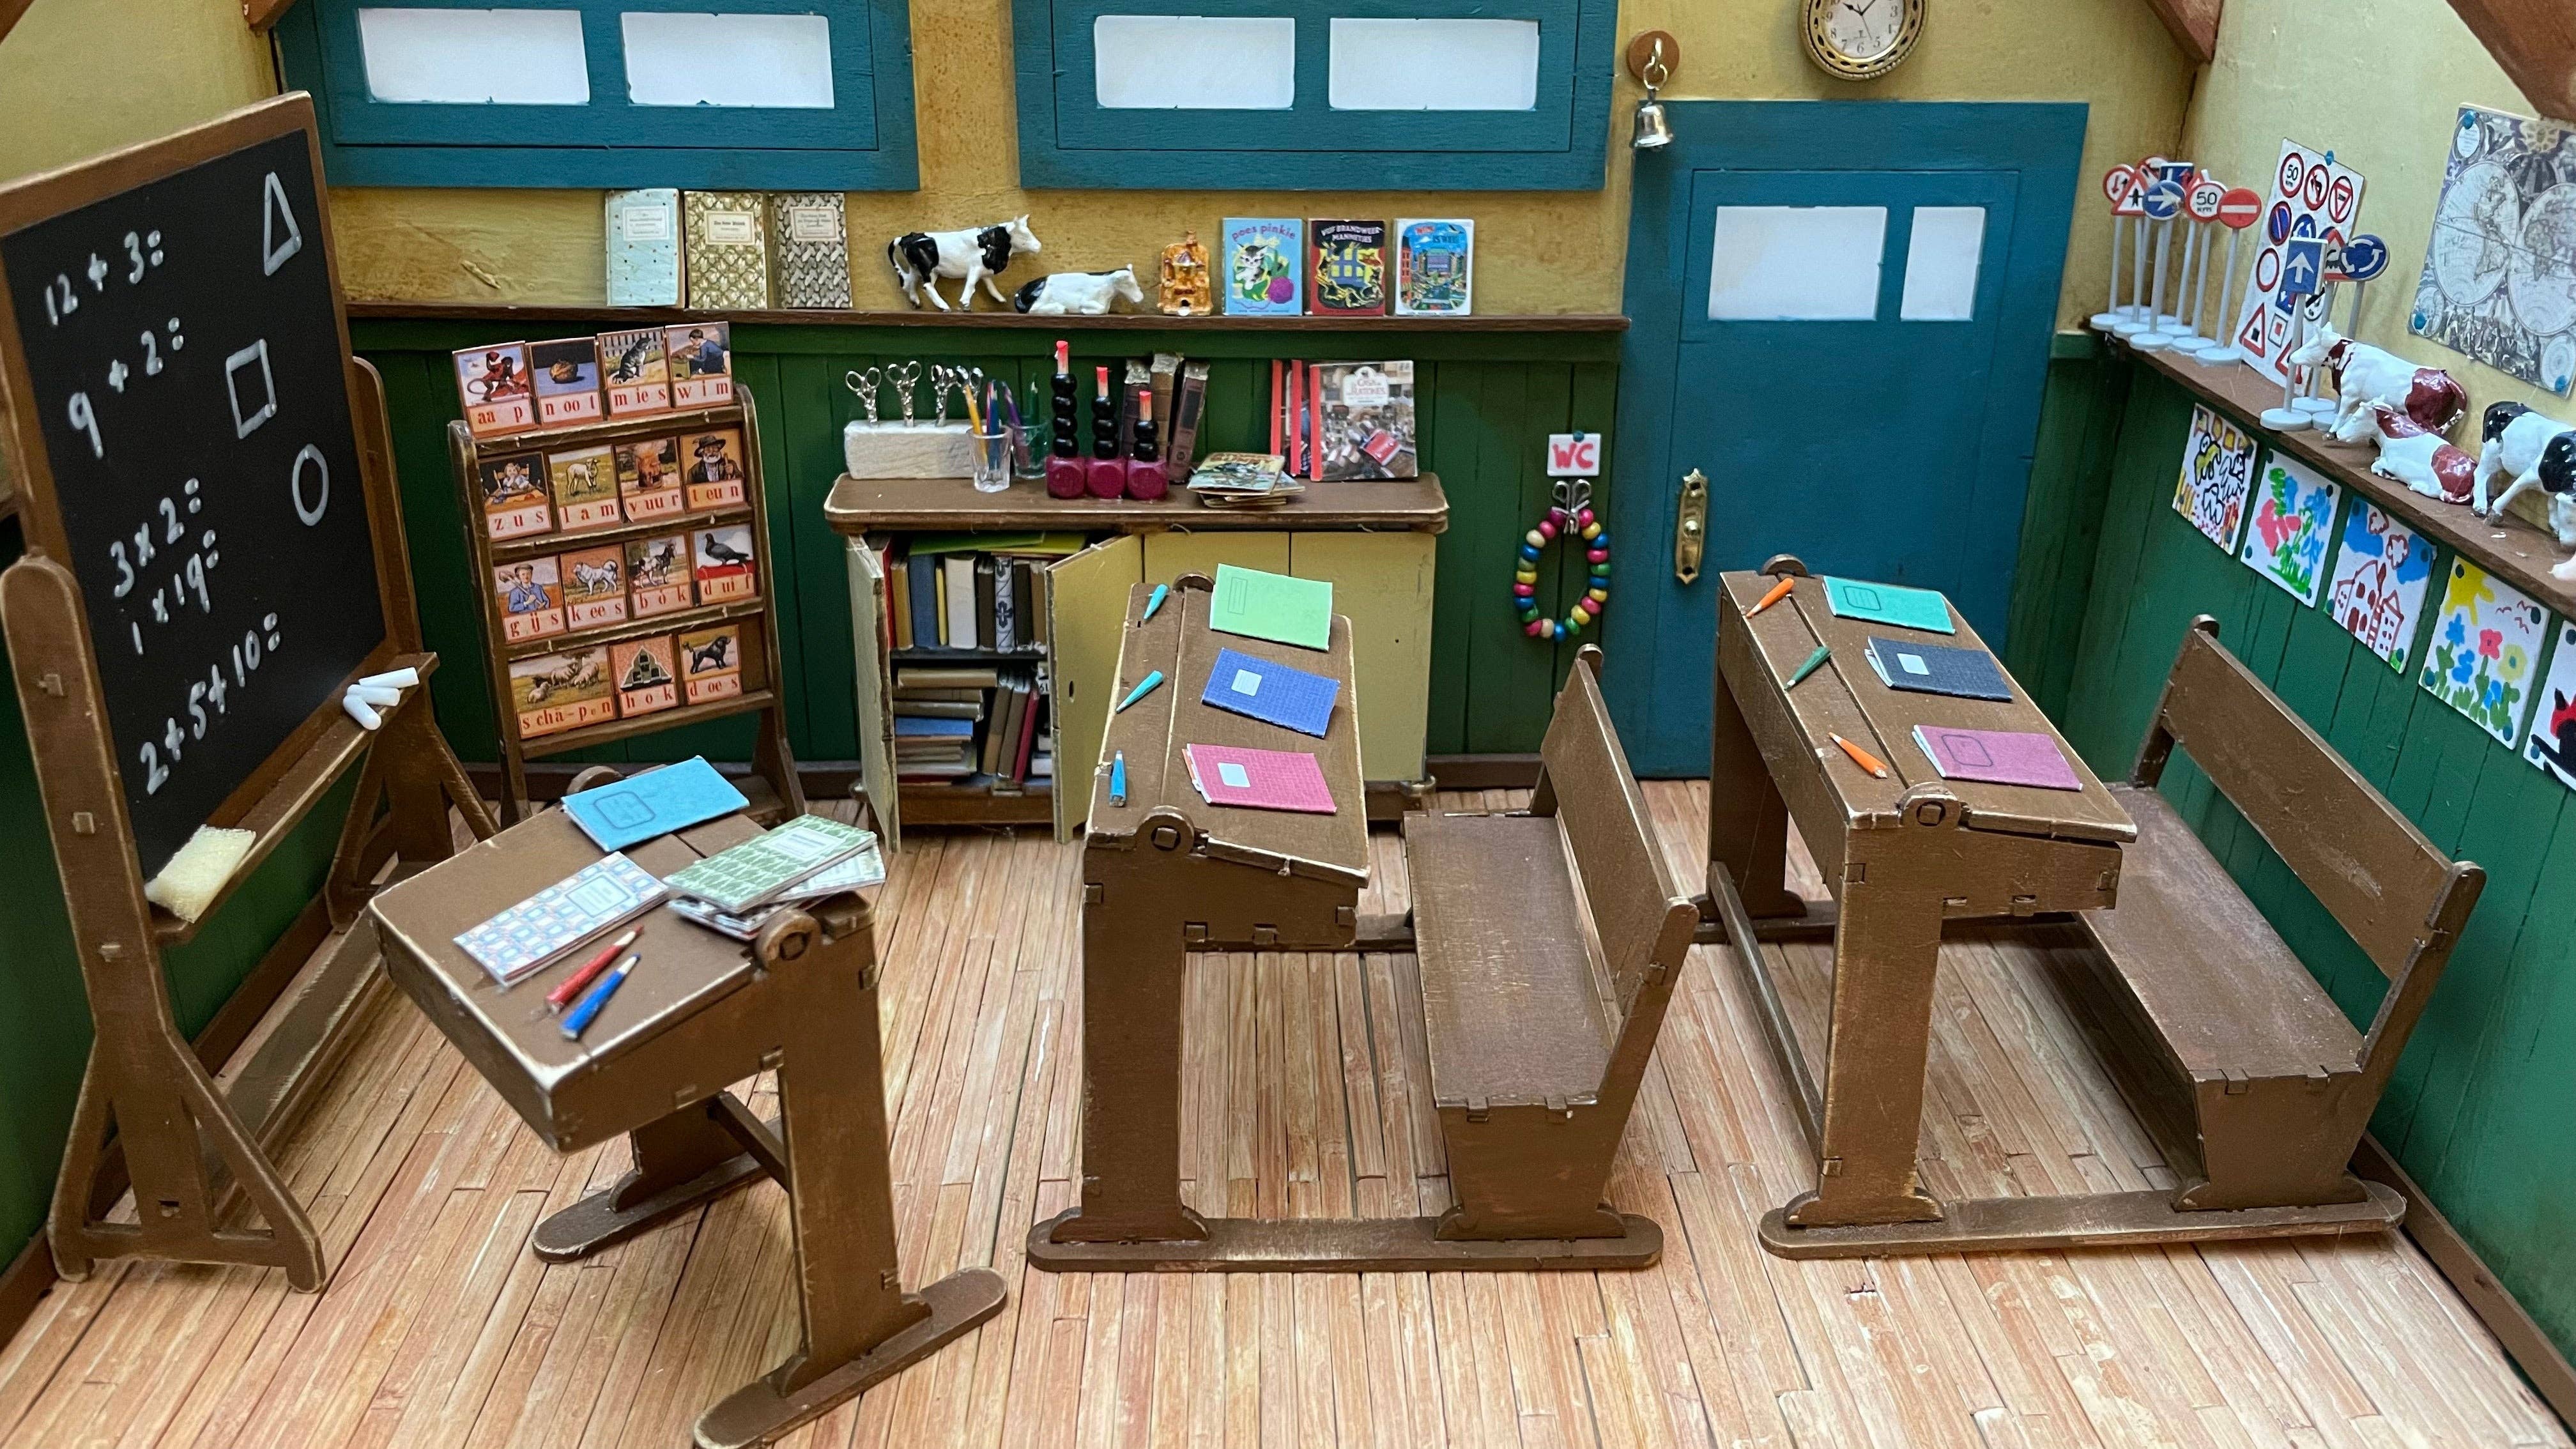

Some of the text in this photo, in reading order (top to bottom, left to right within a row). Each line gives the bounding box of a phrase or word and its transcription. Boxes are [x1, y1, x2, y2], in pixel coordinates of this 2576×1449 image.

[2287, 164, 2299, 181] 50
[2196, 192, 2217, 205] 50
[1232, 222, 1296, 242] poes pinkie
[45, 273, 78, 326] 12
[68, 391, 103, 459] 9
[1552, 442, 1594, 470] WC
